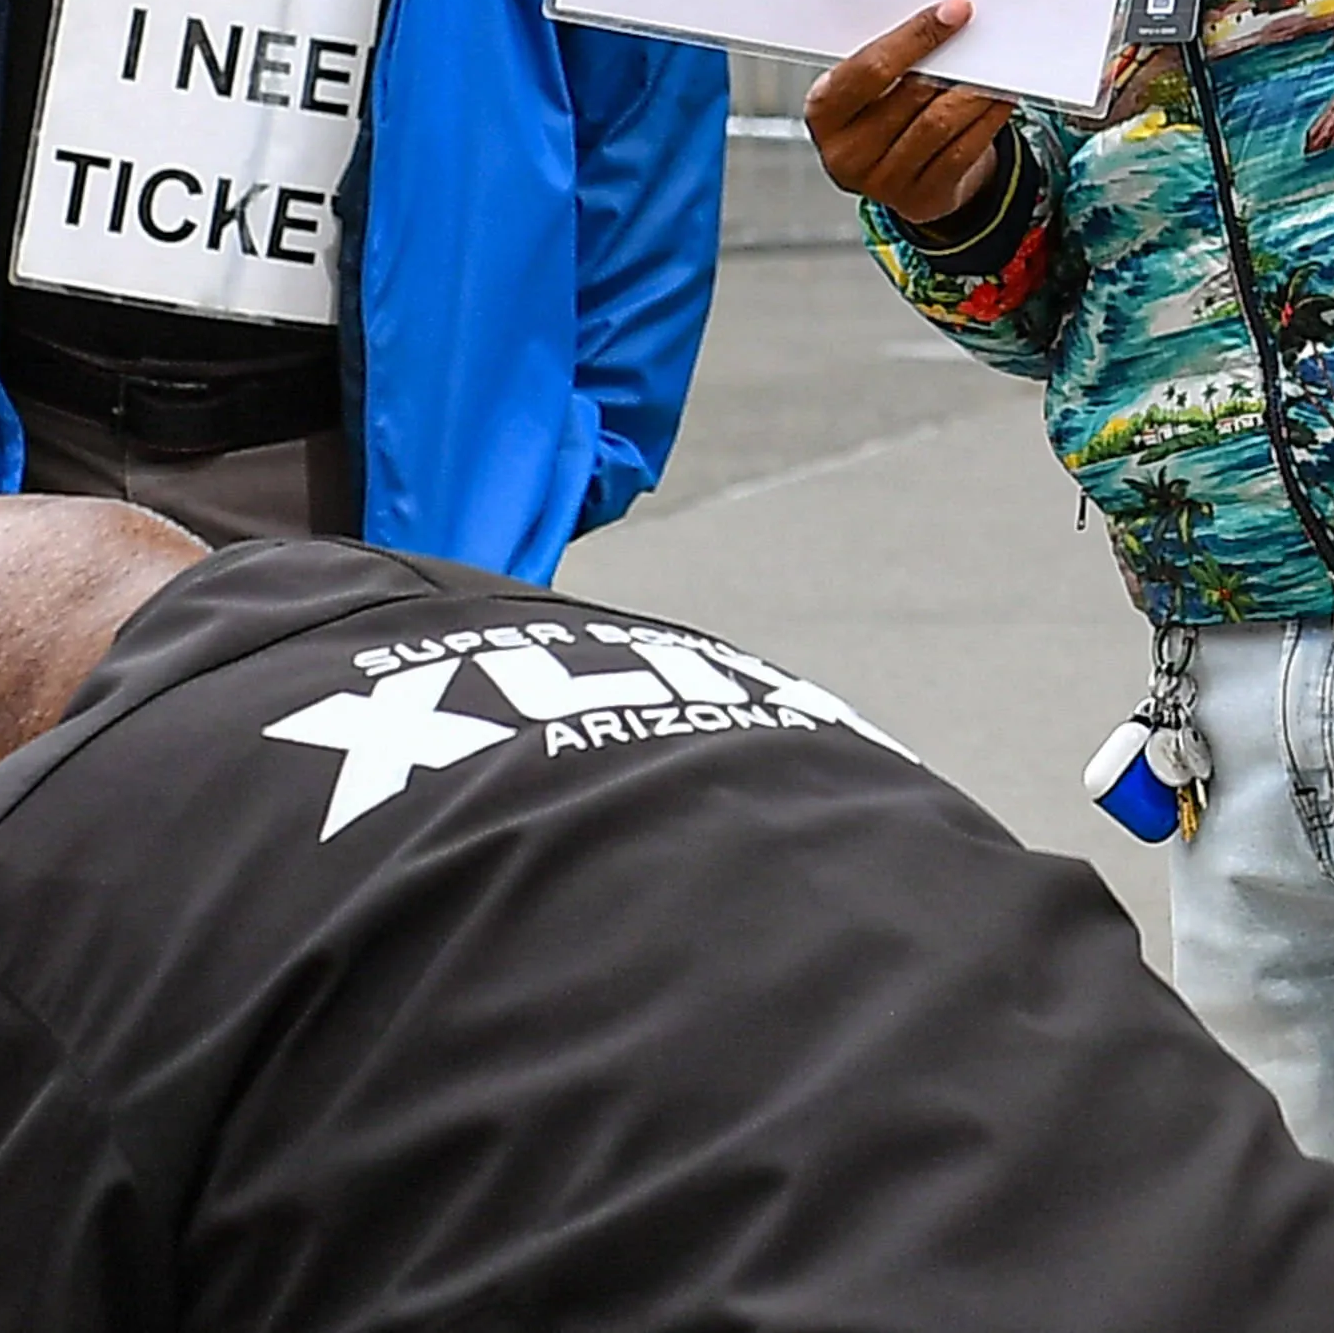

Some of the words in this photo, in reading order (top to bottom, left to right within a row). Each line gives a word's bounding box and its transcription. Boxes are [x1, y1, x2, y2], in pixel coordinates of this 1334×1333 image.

[120, 7, 147, 82] I
[175, 17, 375, 119] NEE
[55, 149, 340, 265] TICKE
[353, 622, 576, 677] SUPER
[544, 704, 817, 757] ARIZONA
